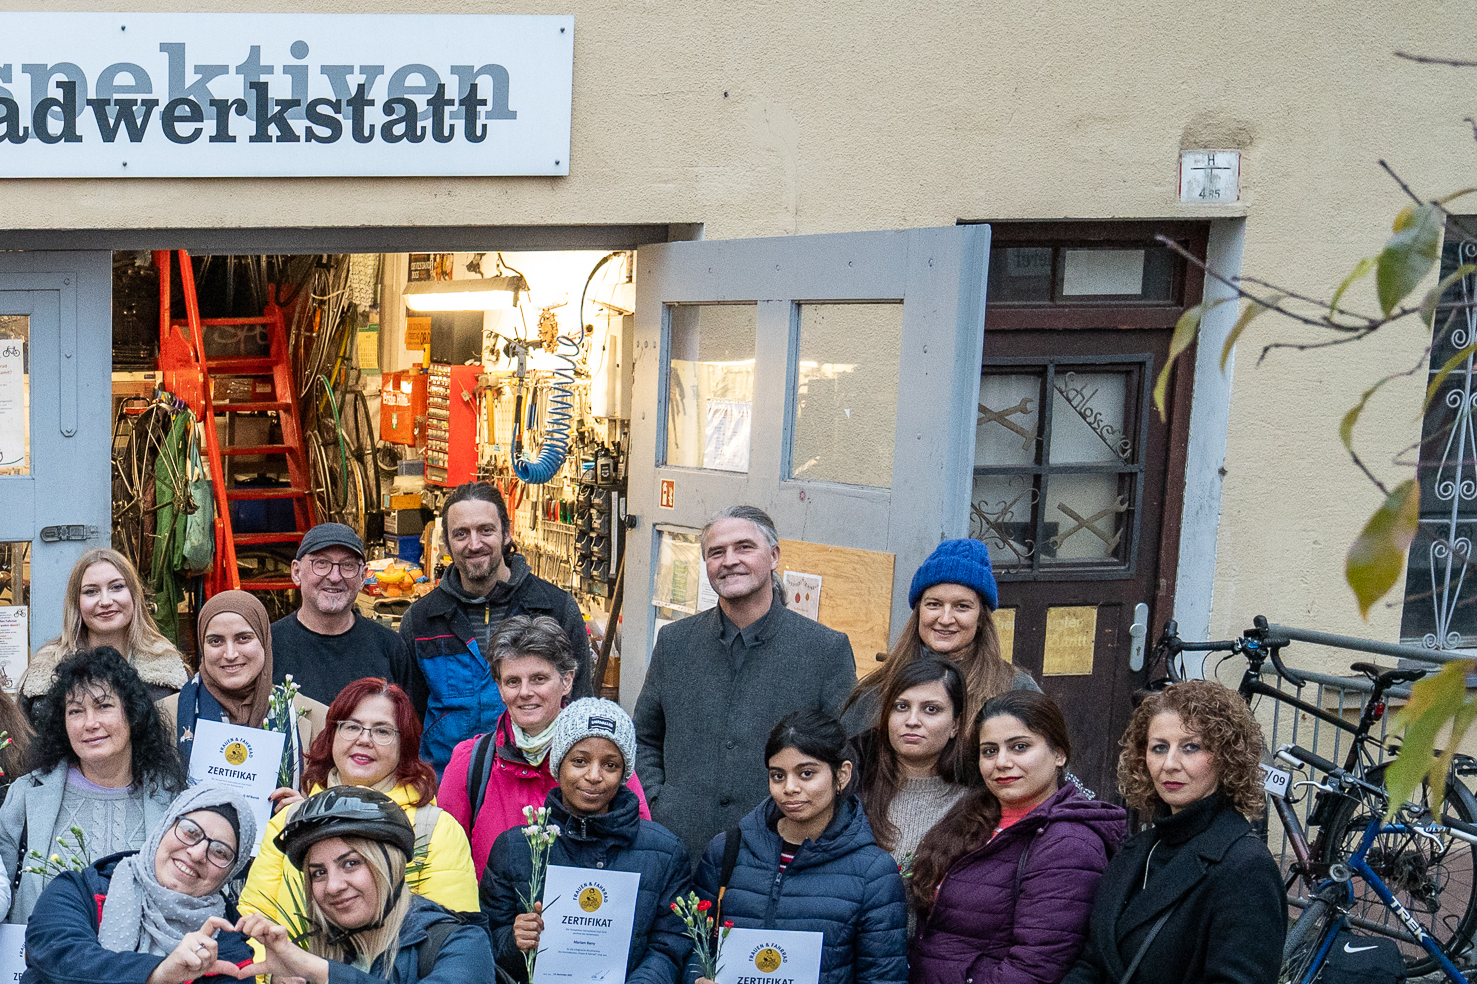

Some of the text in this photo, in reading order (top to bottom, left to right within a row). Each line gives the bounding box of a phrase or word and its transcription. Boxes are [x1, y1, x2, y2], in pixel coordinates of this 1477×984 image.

[219, 738, 234, 754] FRAUEN
[240, 738, 254, 758] FAHRRAD
[208, 766, 257, 781] ZERTIFIKAT
[572, 883, 588, 900] FRAUEN
[594, 882, 608, 903] FAHRRAD
[562, 916, 613, 927] ZERTIFIKAT
[1390, 896, 1429, 942] TREK
[749, 944, 764, 962] FRAUEN
[771, 943, 788, 963] FAHRRAD
